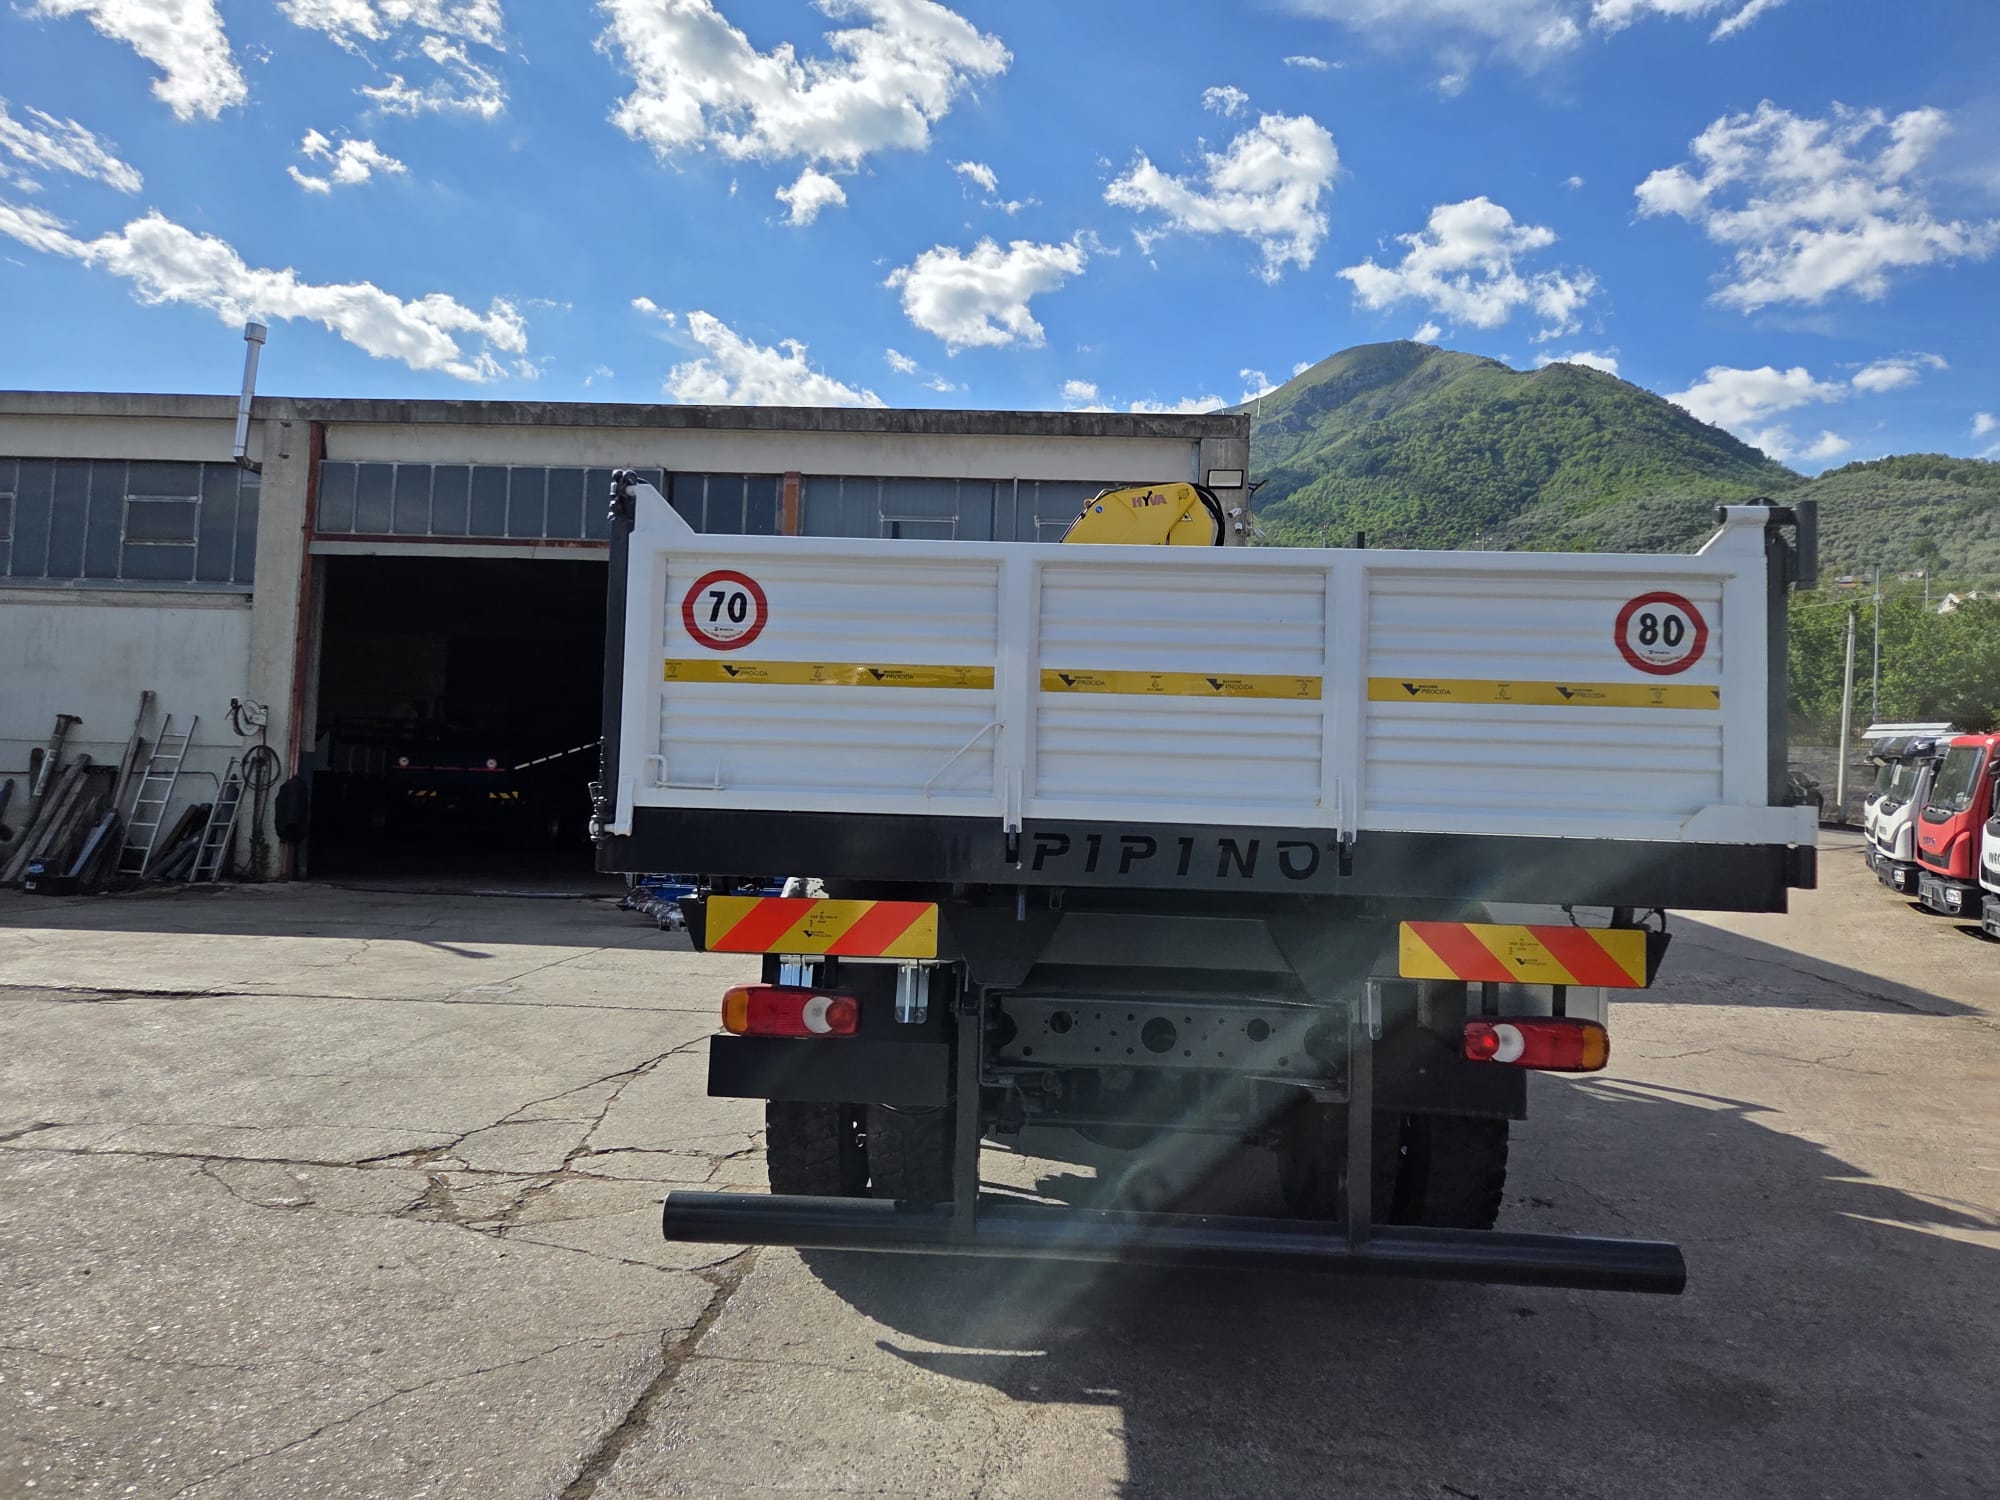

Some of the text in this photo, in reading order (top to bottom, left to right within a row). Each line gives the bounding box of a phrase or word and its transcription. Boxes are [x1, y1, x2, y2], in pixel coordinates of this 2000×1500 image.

[1131, 491, 1167, 508] HYVA
[709, 591, 747, 623] 70
[1639, 613, 1684, 647] 80
[1031, 832, 1320, 880] PIPINO
